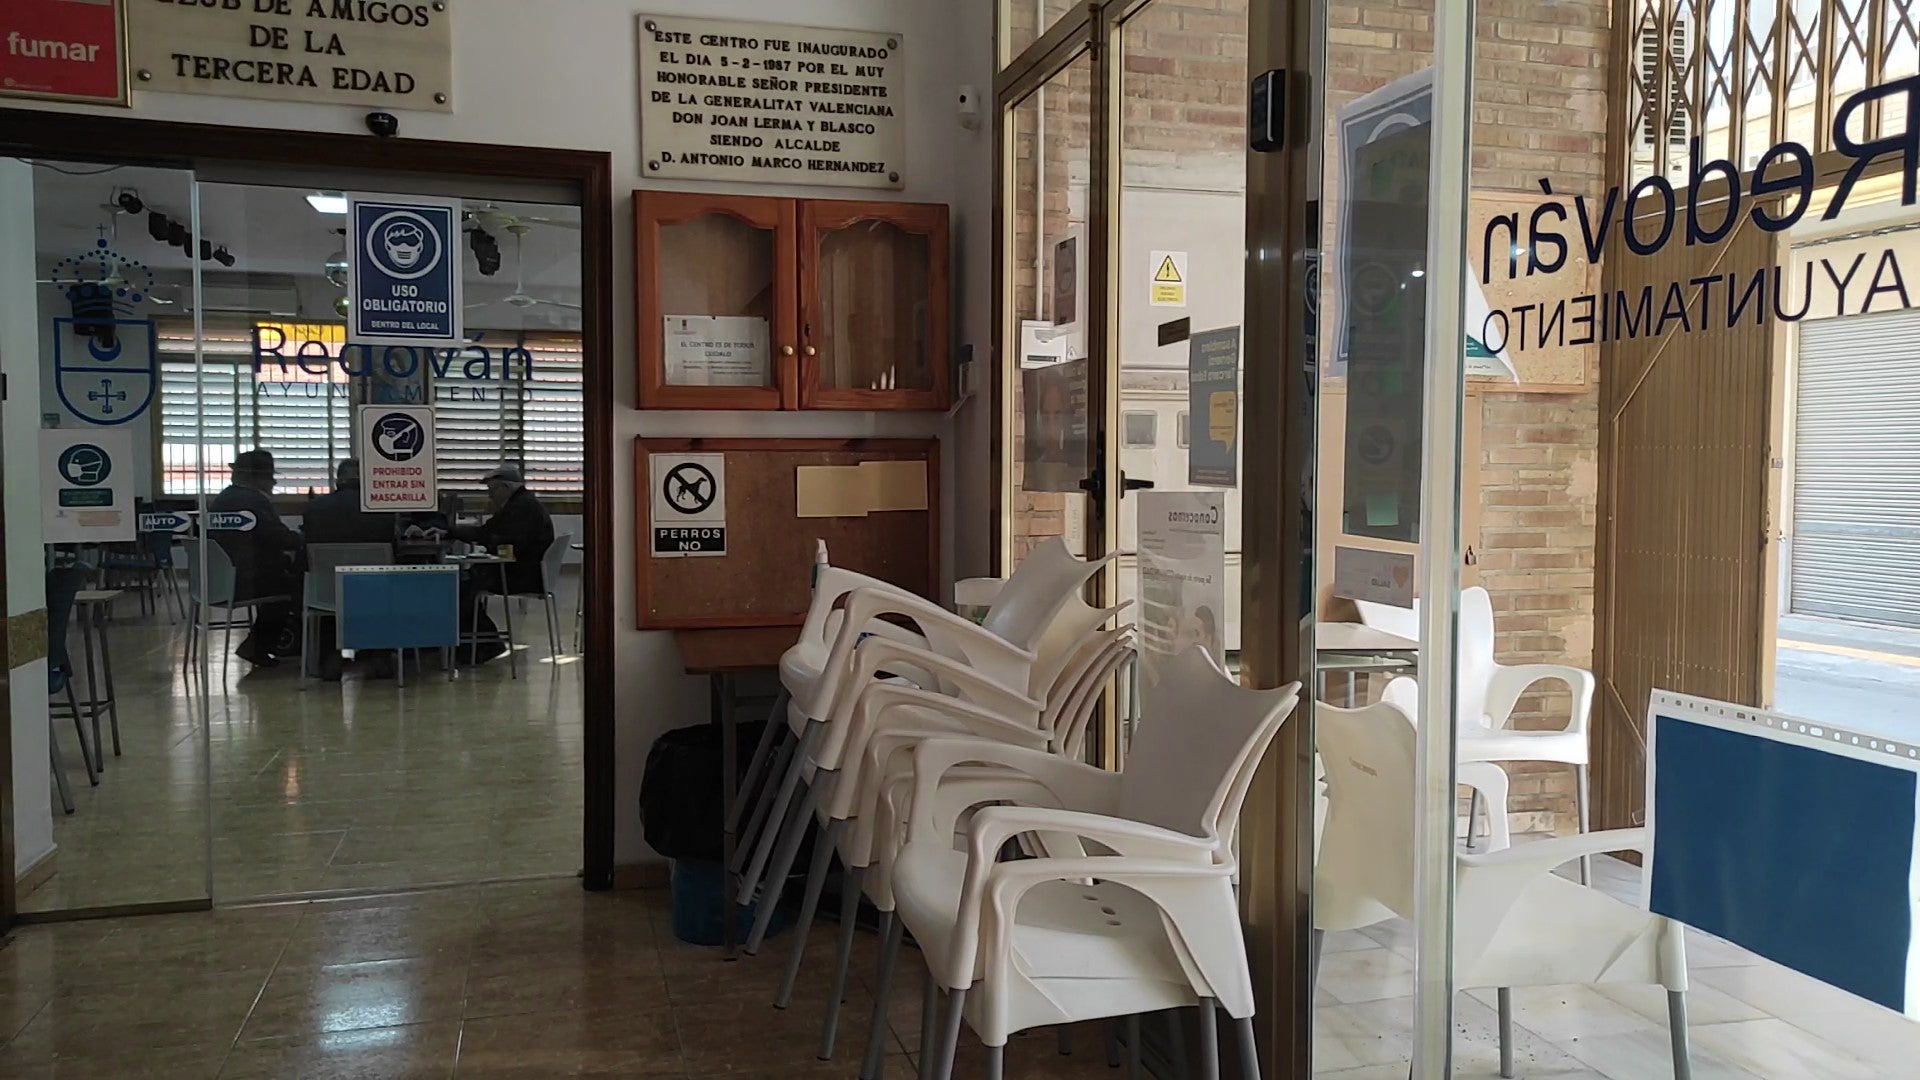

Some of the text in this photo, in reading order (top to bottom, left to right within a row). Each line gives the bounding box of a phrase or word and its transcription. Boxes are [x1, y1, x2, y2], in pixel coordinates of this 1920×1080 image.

[253, 0, 292, 16] DE
[306, 0, 430, 28] AMIGOS
[7, 32, 100, 62] fumar
[249, 24, 346, 56] DE LA
[654, 30, 888, 59] ESTE CENTRO FUE INAUGURADO
[171, 53, 415, 95] TERCERA EDAD
[660, 51, 679, 64] EL
[686, 53, 712, 66] DIA
[797, 61, 825, 74] POR
[831, 63, 849, 76] EL
[855, 65, 884, 78] MUY
[657, 71, 888, 98] HONORABLE SEÑOR PRESIDENTE
[651, 90, 894, 117] DE LA GENERALITAT VALENCIANA
[672, 111, 876, 135] DON JOAN LERMA Y BLASCO
[709, 134, 841, 152] SIENDO ALCALDE
[661, 151, 886, 174] D. ANTONIO MARCO HERNANDEZ
[391, 285, 418, 298] USO
[362, 298, 448, 314] OBLIGATORIO
[371, 320, 440, 330] DENTRO DEL LOCAL
[252, 325, 534, 381] Redován
[256, 381, 533, 403] AYUNTAMIENTO
[372, 467, 422, 476] PROHIBIDO
[373, 480, 425, 489] ENTRAR SIN
[370, 493, 427, 502] MASCARILLA
[145, 516, 176, 526] AUTO
[211, 516, 242, 524] AUTO
[660, 529, 721, 539] PERROS
[679, 541, 701, 551] NO
